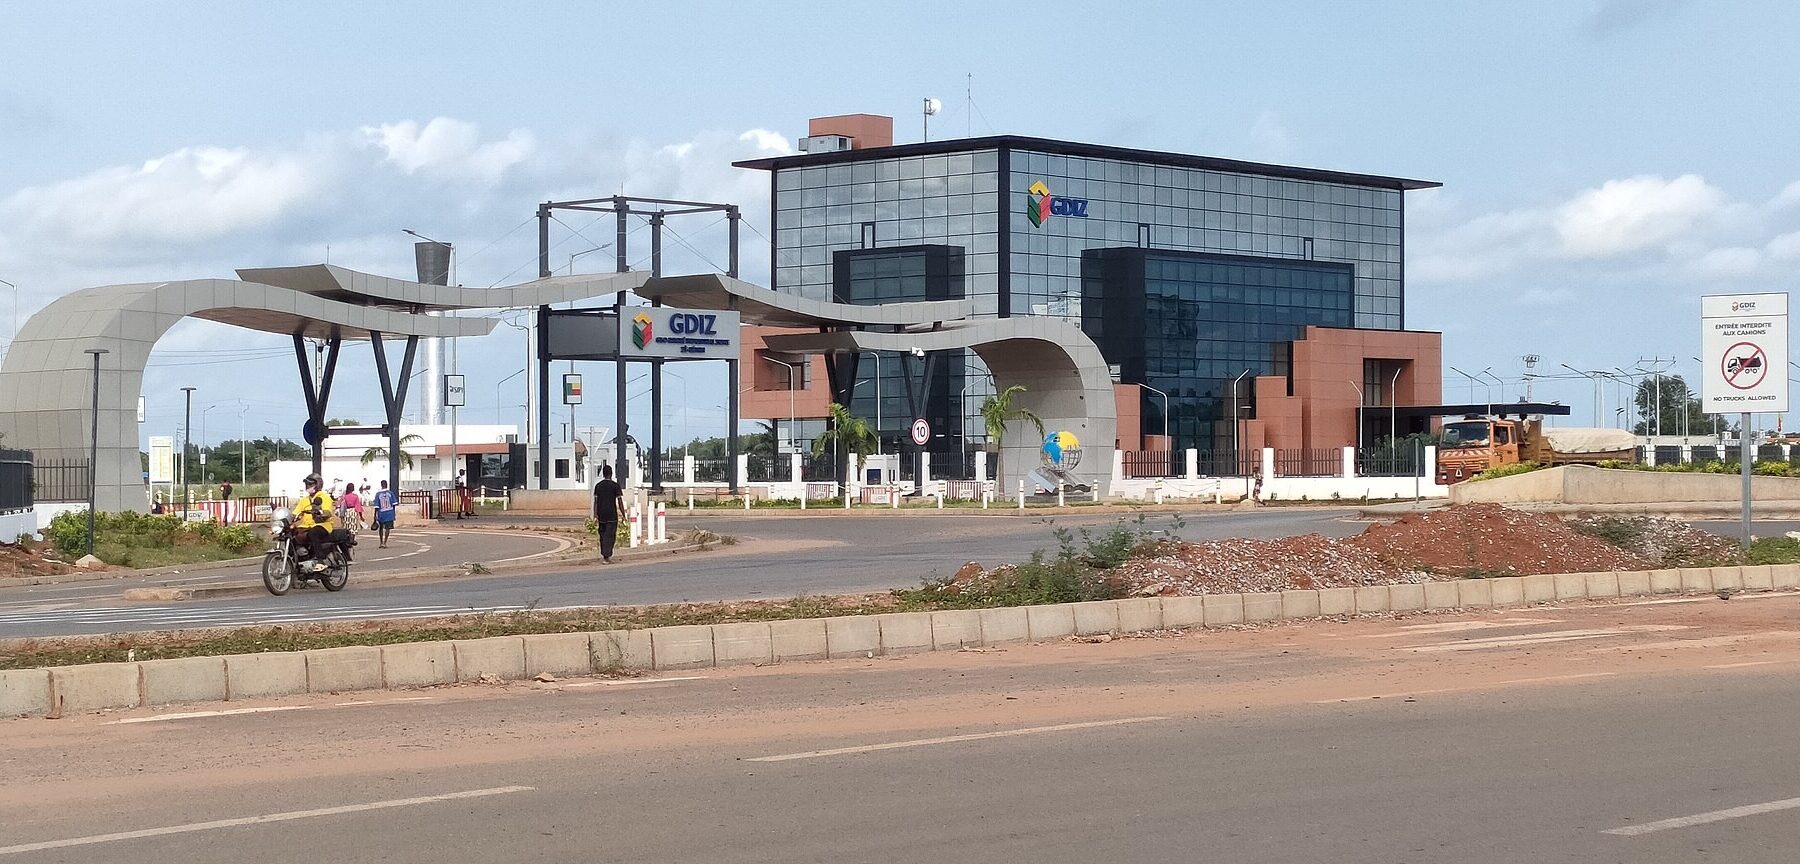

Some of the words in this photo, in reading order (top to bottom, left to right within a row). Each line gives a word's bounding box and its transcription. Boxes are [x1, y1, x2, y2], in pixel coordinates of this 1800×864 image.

[1050, 197, 1089, 217] GDIZ
[669, 313, 717, 335] GDIZ
[916, 426, 926, 438] 10
